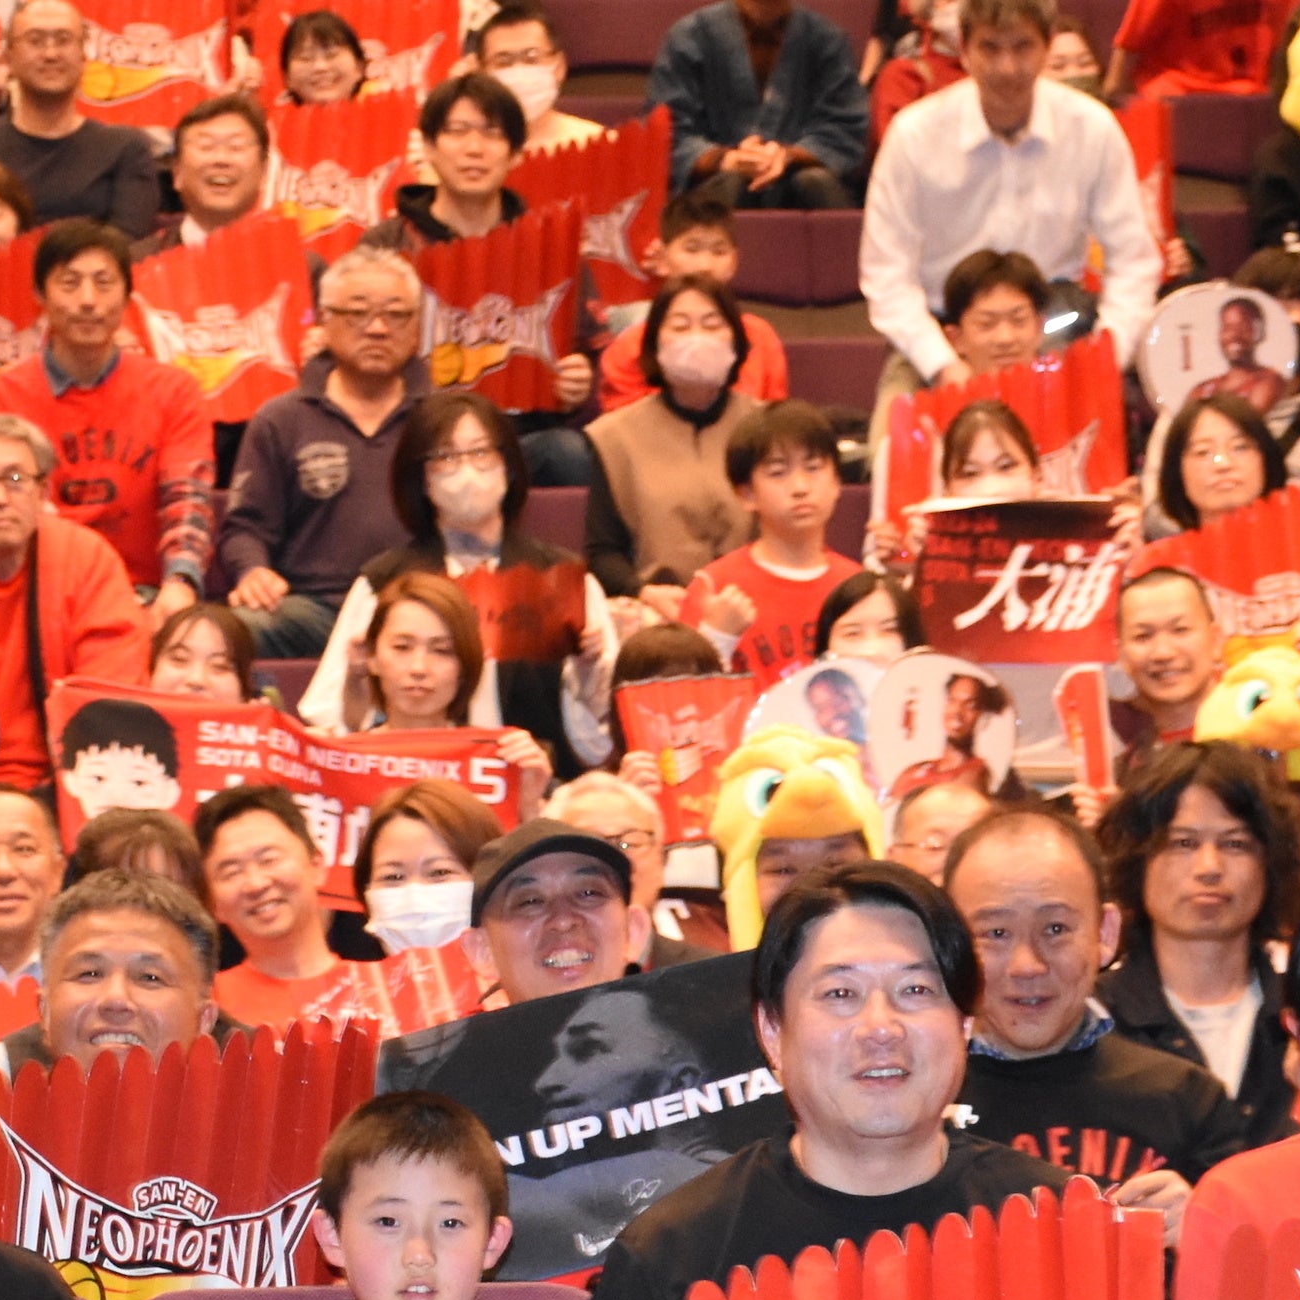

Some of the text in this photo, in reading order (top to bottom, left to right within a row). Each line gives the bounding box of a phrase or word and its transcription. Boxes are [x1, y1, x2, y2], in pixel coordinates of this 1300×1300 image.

[196, 746, 262, 769] SOTA
[468, 757, 507, 804] 5
[527, 1116, 603, 1159] UP
[607, 1066, 784, 1140] MENTA
[4, 1140, 321, 1289] NEOPHOENIX
[137, 1179, 212, 1220] SAN-EN
